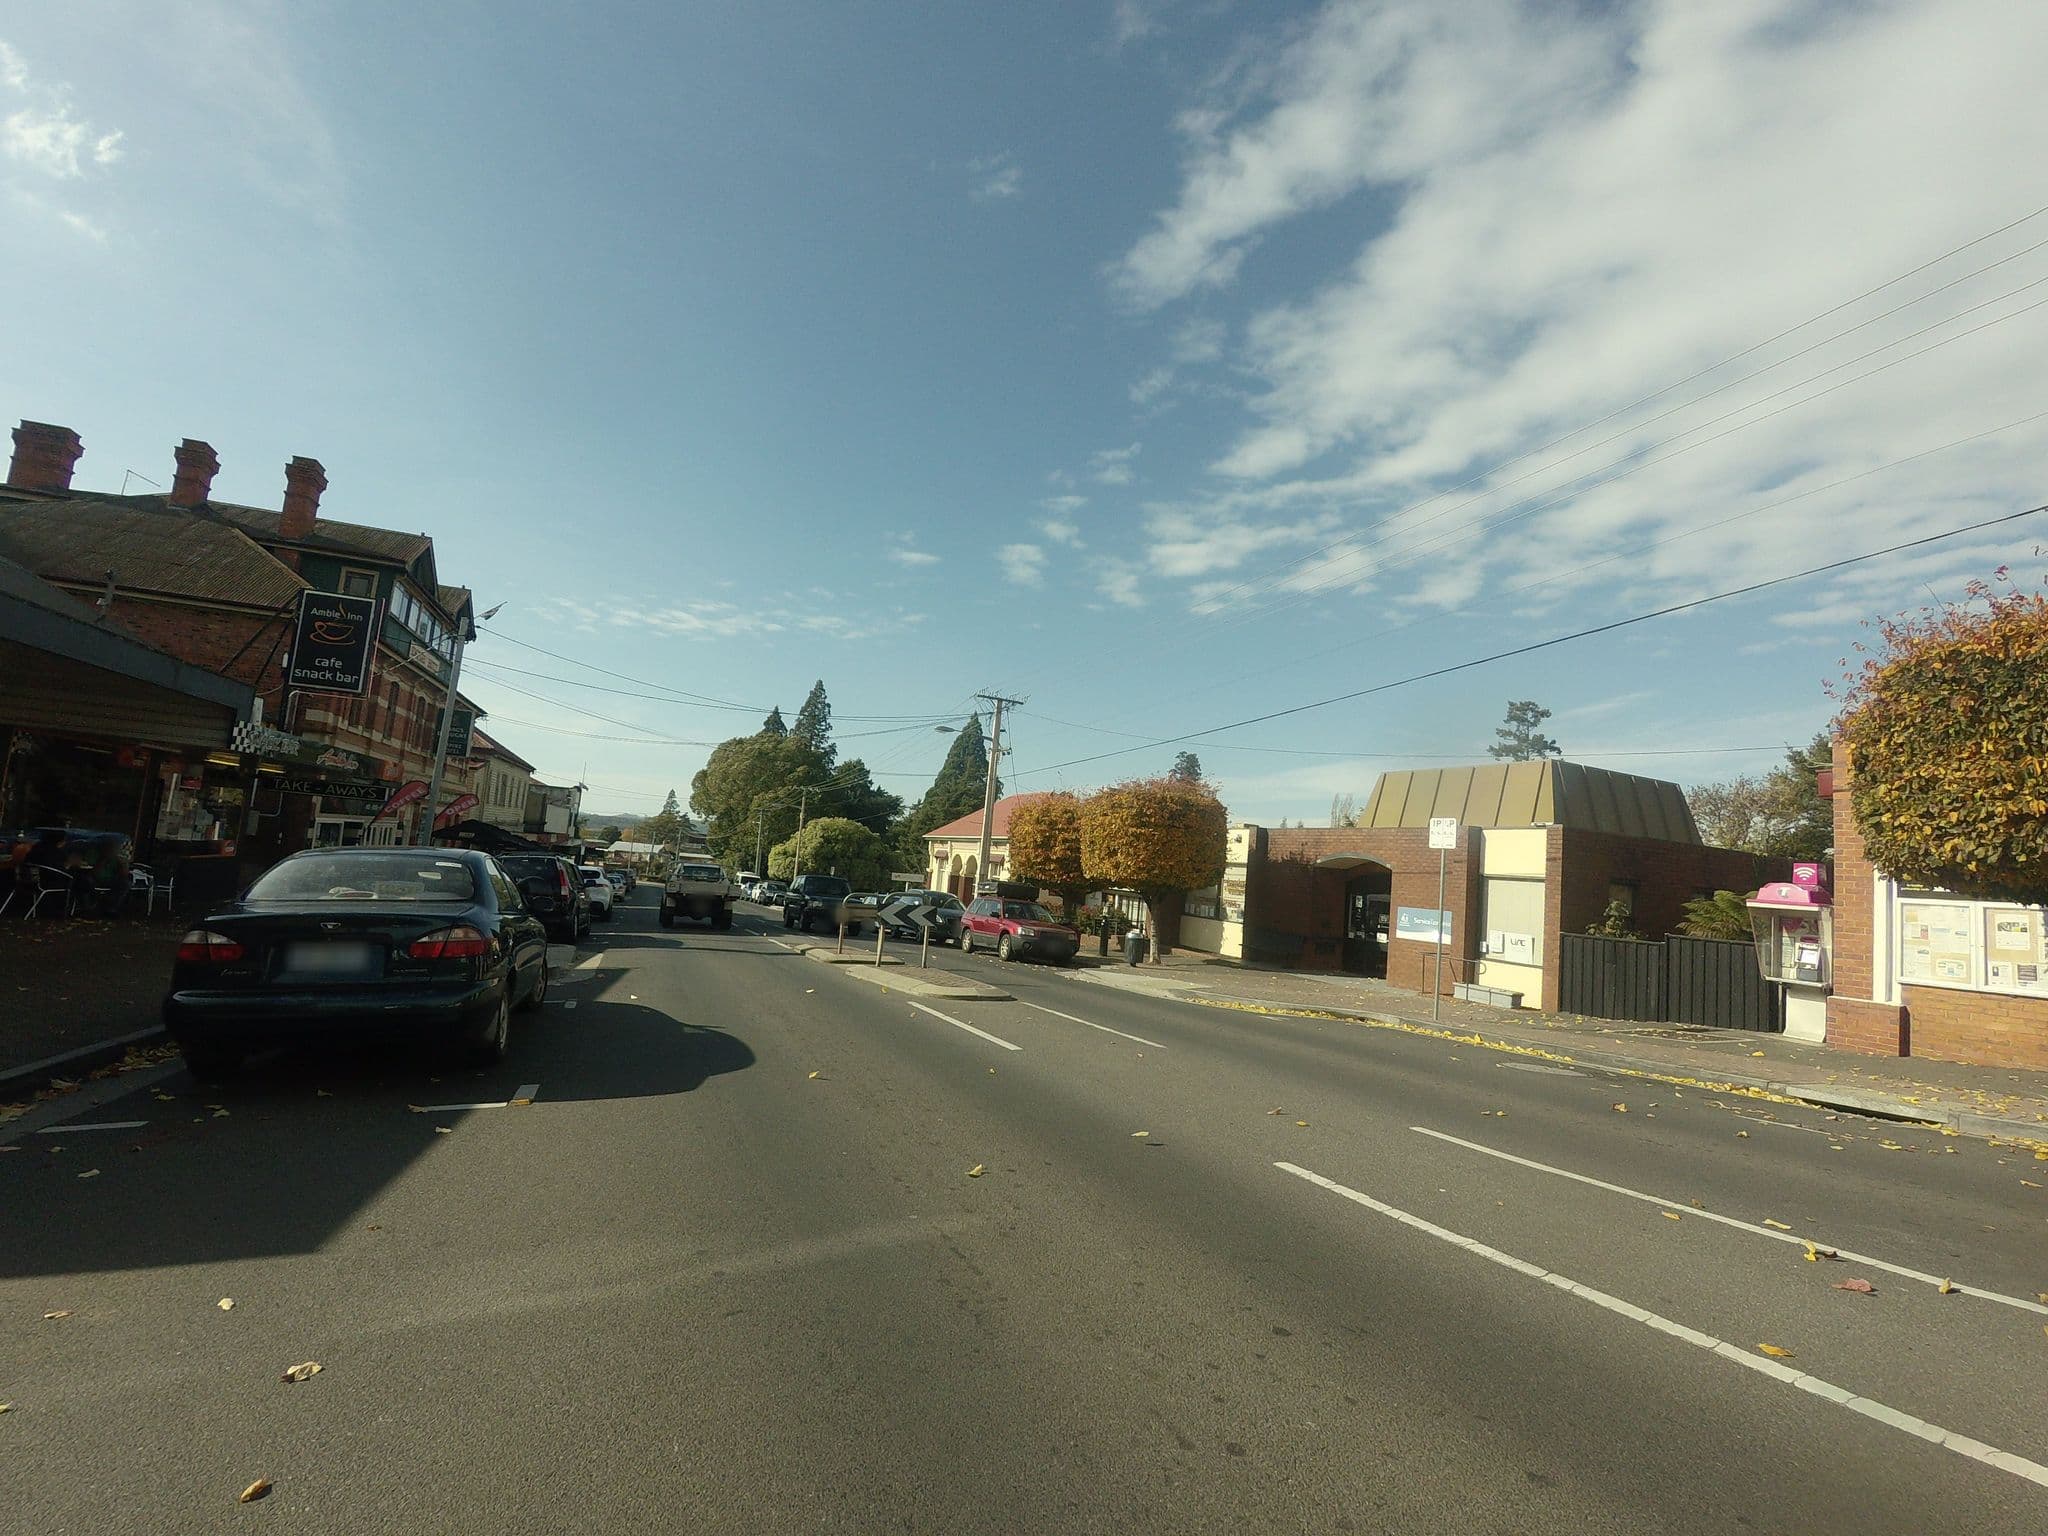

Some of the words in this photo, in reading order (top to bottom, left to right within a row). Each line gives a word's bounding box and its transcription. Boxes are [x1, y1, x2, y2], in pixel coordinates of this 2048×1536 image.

[311, 607, 341, 618] Amble
[347, 612, 363, 621] Inn
[315, 657, 343, 668] cafe
[294, 668, 333, 680] snack
[336, 671, 359, 683] bar
[273, 777, 312, 793] TAKE
[325, 783, 378, 799] AWAYS
[446, 798, 478, 816] OPEN
